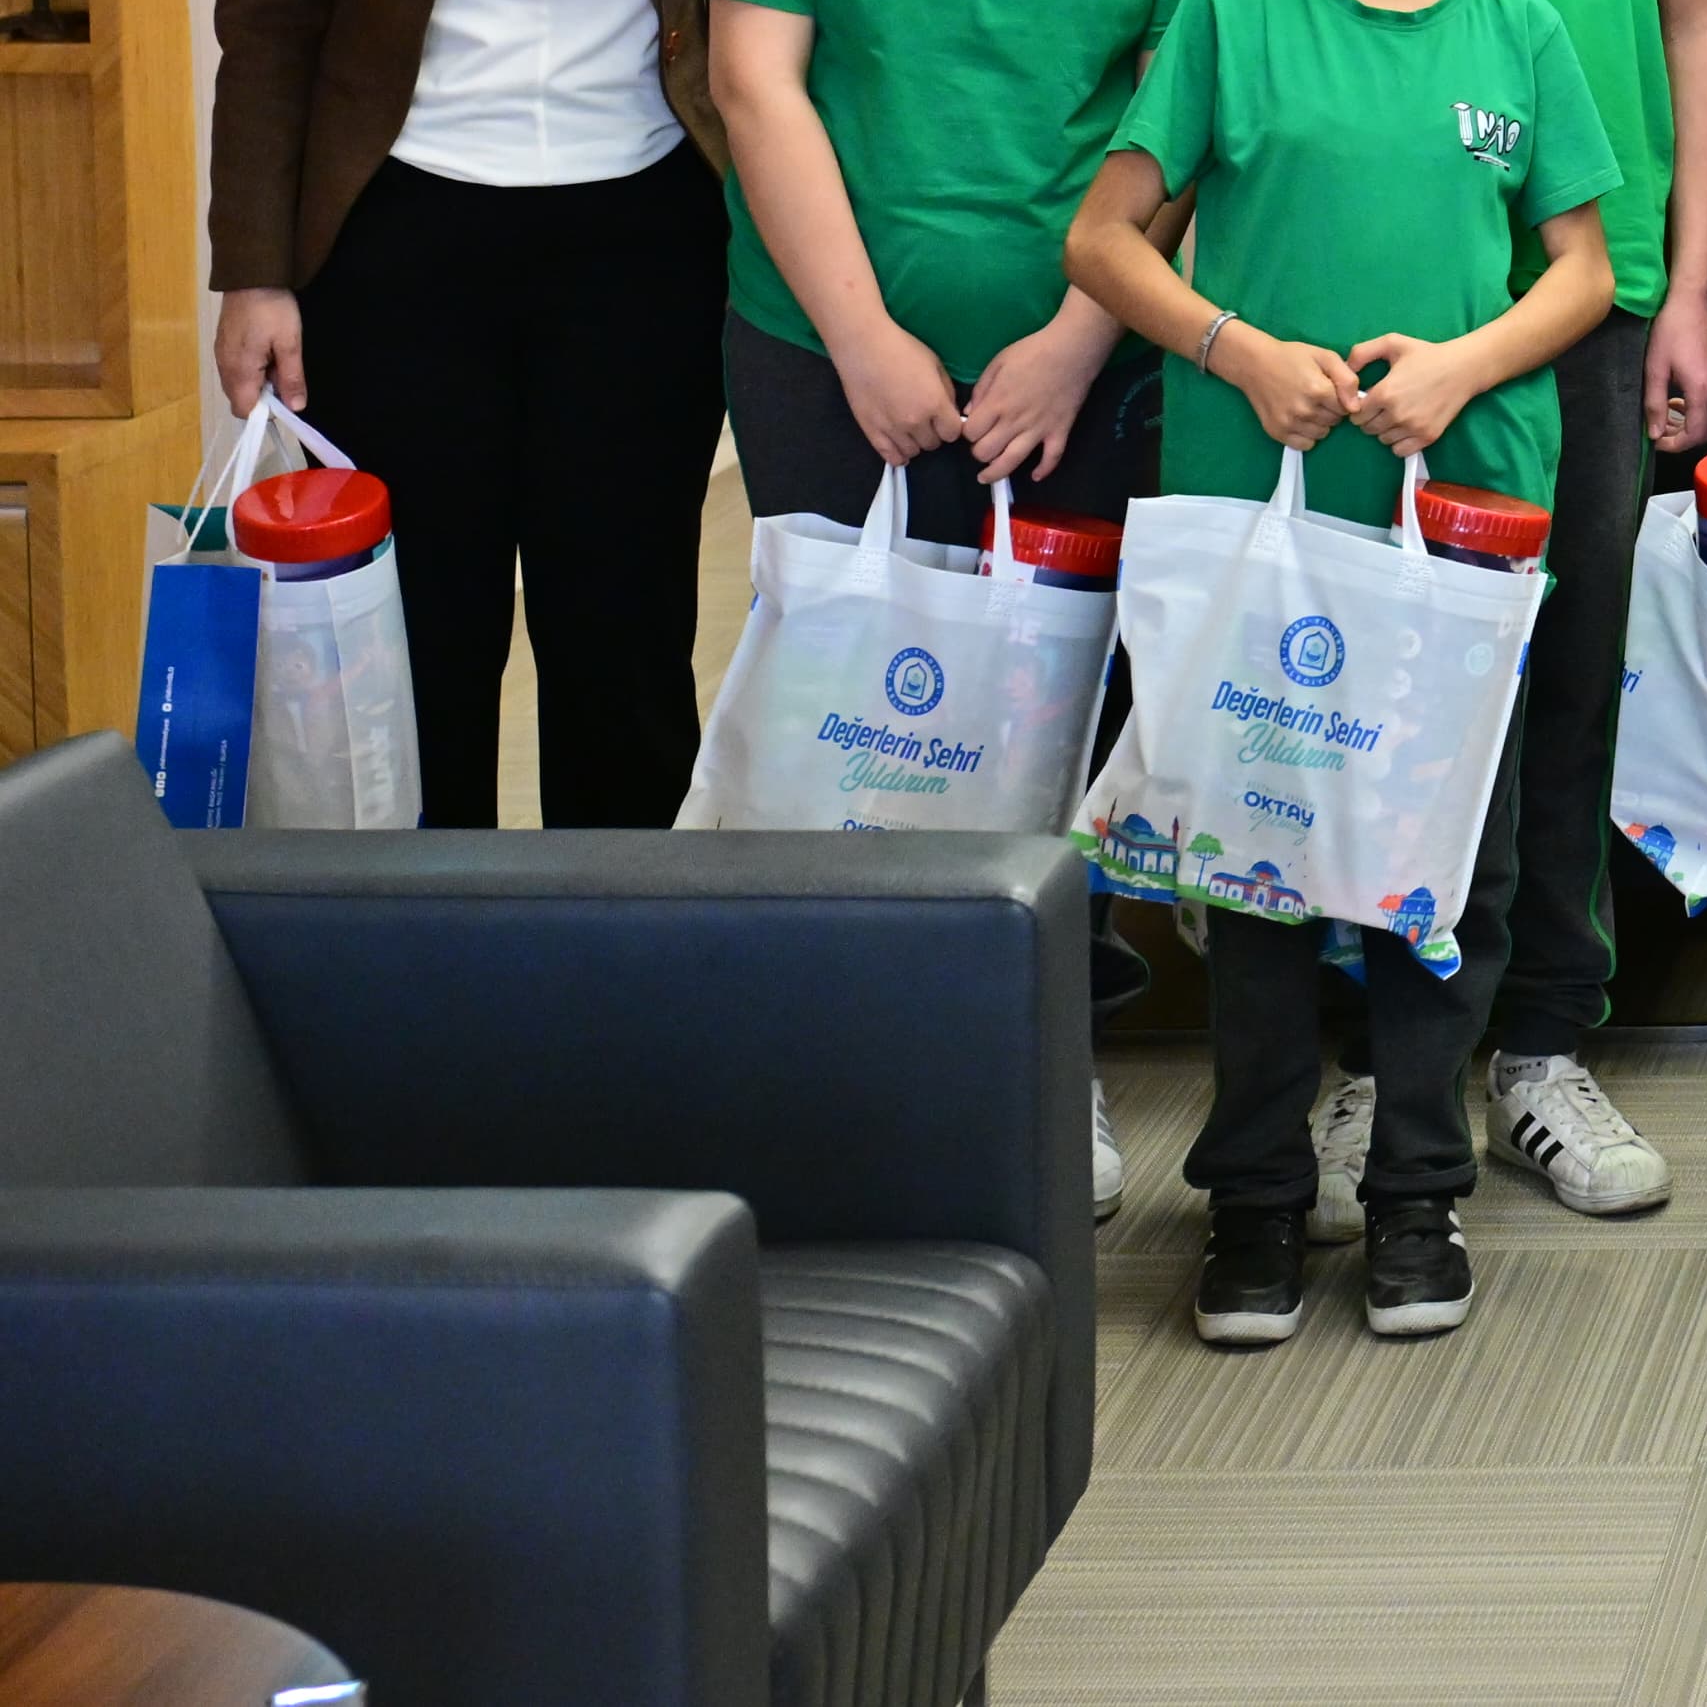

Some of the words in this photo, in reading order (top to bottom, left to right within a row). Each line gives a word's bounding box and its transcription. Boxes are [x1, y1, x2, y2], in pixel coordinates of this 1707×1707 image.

[817, 712, 922, 762] Değerlerin
[923, 738, 985, 773] Şehri
[1211, 681, 1324, 735] Değerlerin
[1325, 711, 1384, 752] Şehri
[1243, 790, 1315, 828] OKTAY
